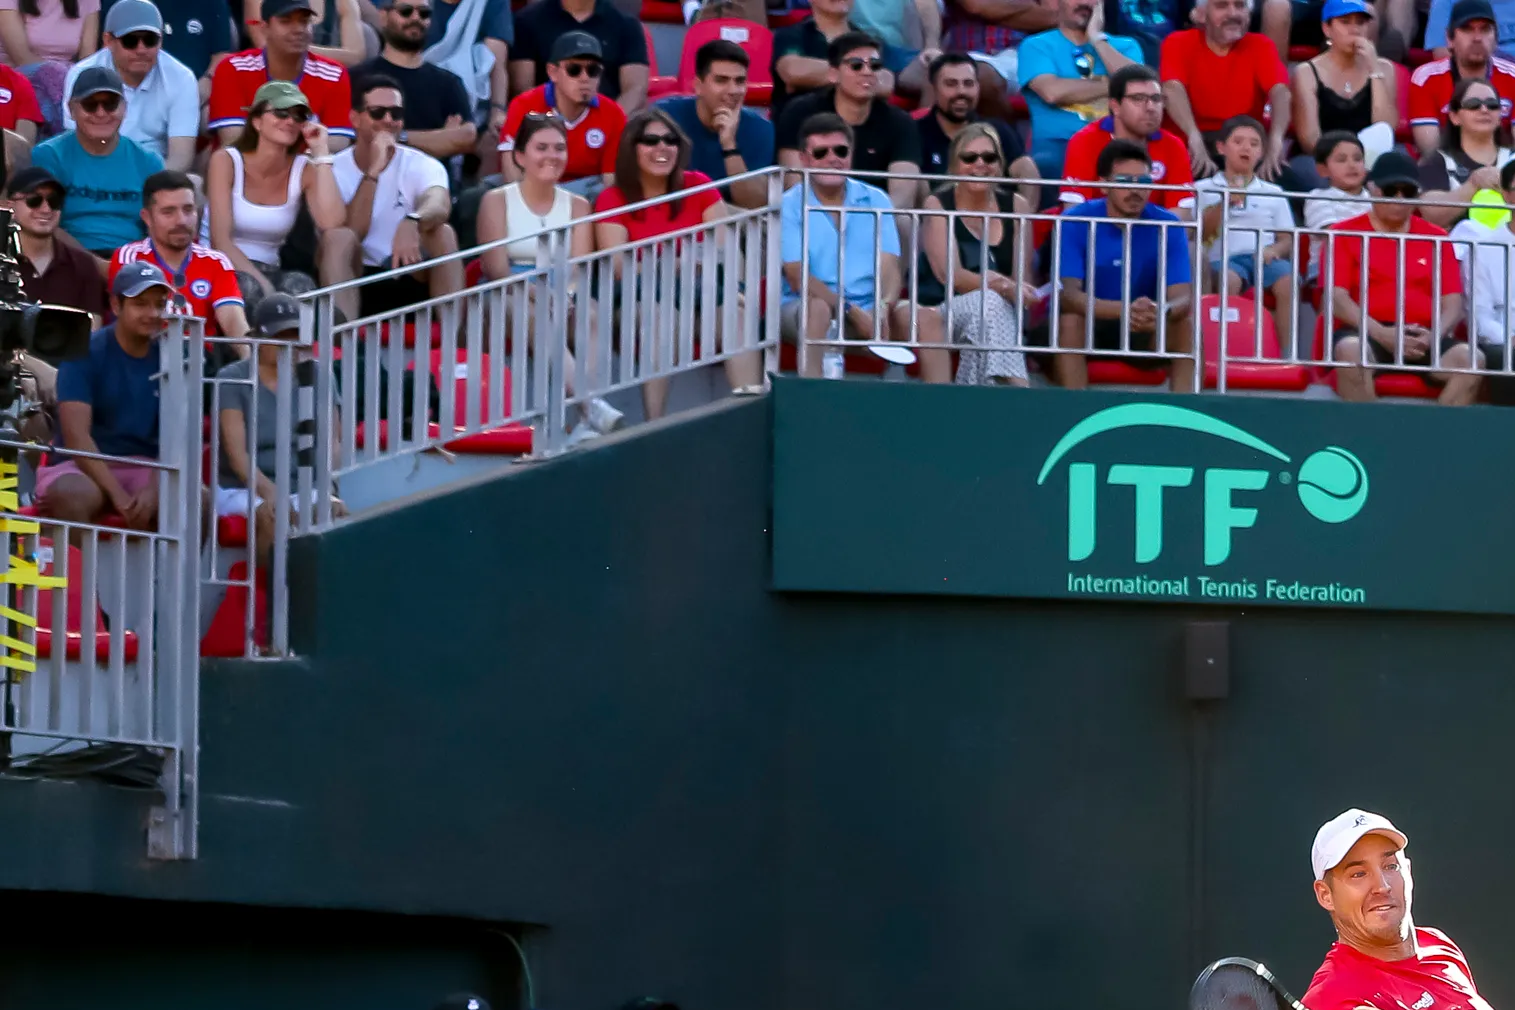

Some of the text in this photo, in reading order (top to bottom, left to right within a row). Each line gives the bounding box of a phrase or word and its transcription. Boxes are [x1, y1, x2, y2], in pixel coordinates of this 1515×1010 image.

[1068, 462, 1269, 566] ITF
[1067, 572, 1366, 602] International Tennis Federation
